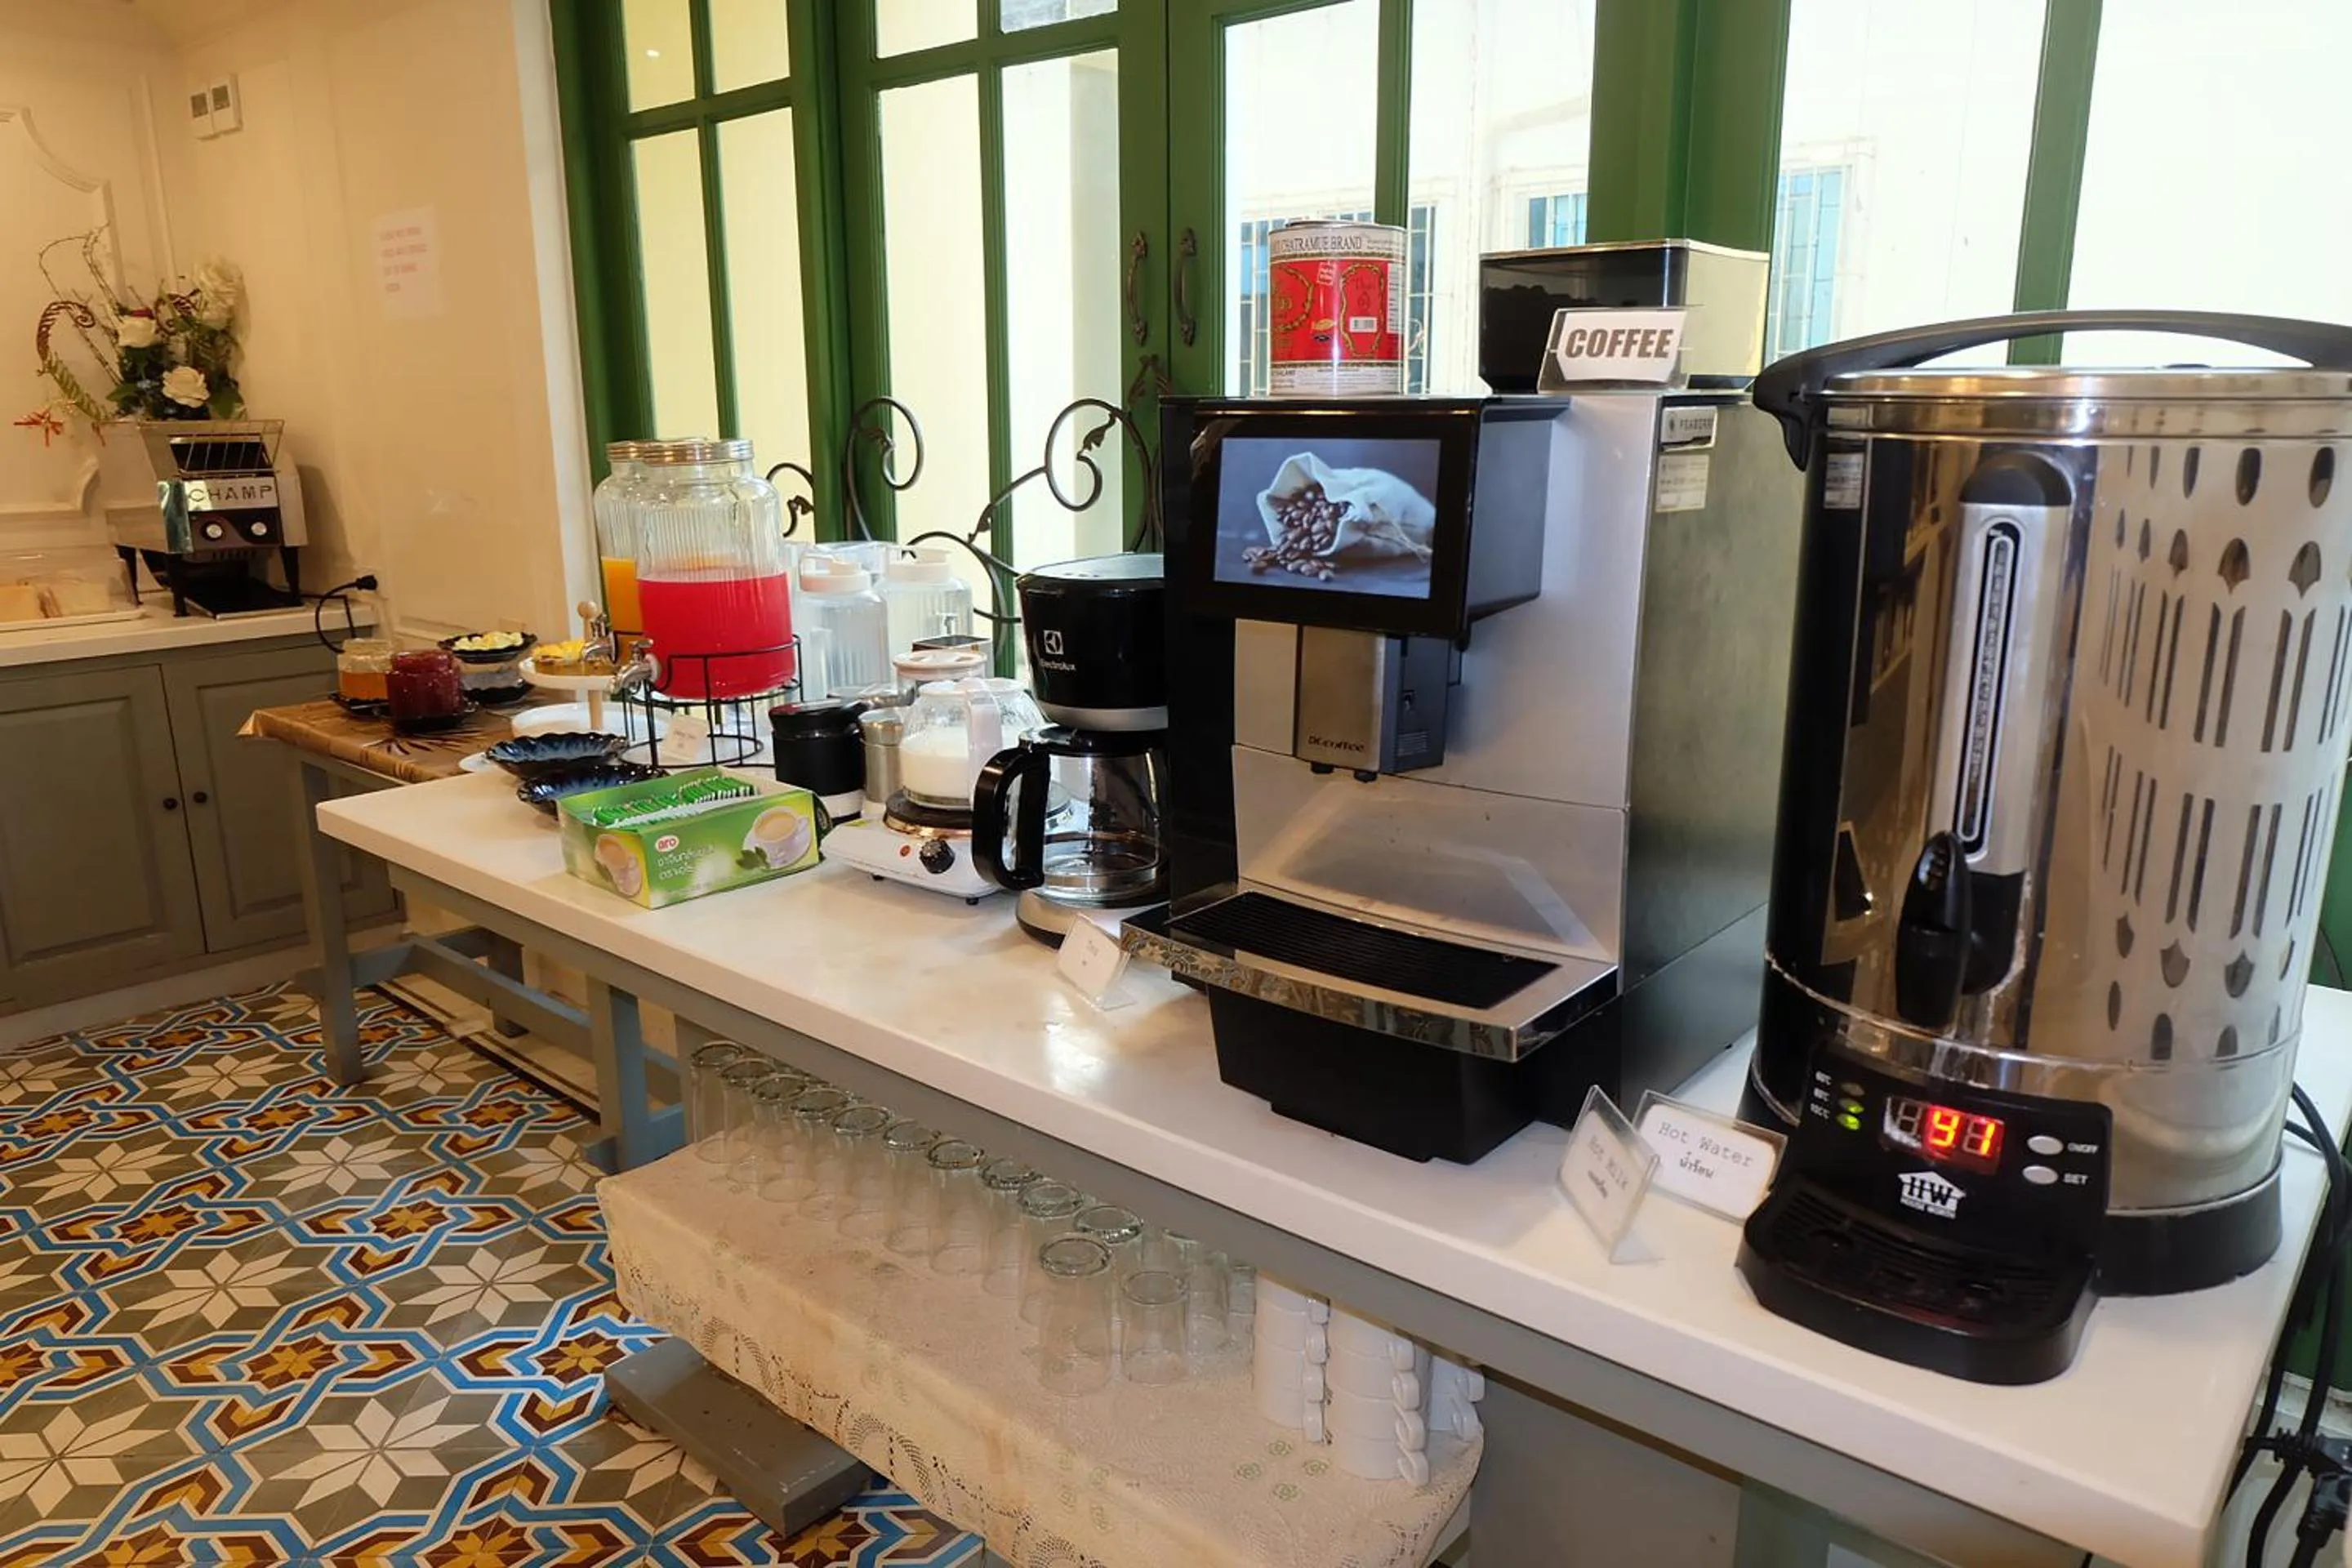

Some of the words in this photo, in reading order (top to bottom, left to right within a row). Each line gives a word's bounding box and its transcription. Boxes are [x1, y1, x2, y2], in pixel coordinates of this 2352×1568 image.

[1331, 235, 1362, 251] BRAND
[1565, 328, 1674, 359] COFFEE
[188, 485, 273, 502] CHAMP
[1658, 1121, 1689, 1144] Hot
[1699, 1136, 1753, 1167] Water
